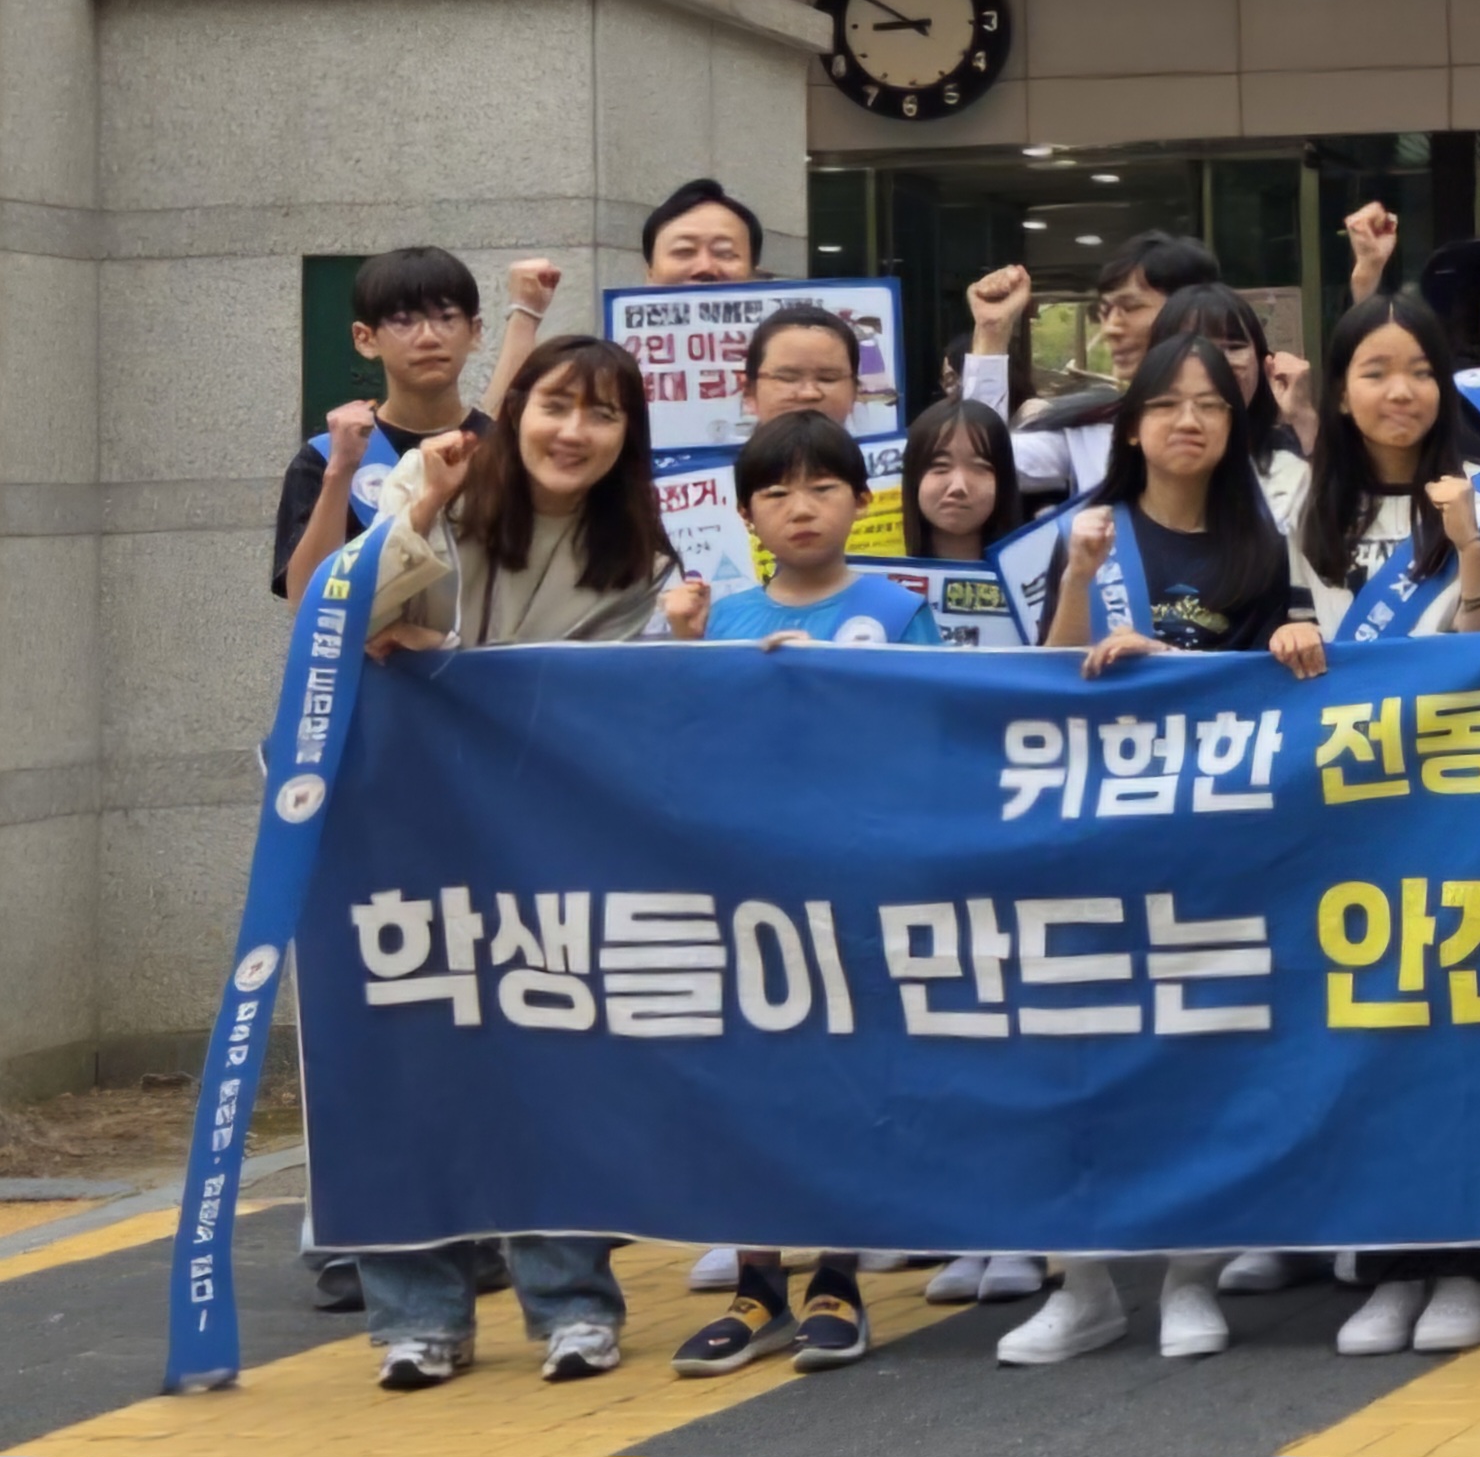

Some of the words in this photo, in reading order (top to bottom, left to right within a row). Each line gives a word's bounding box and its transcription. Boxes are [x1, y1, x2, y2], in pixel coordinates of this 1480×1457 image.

[982, 10, 998, 32] 3
[903, 95, 918, 117] 6
[654, 478, 727, 513] 전거,
[1001, 708, 1283, 822] 위험한
[350, 884, 855, 1039] 학생들이
[878, 891, 1273, 1040] 만드는
